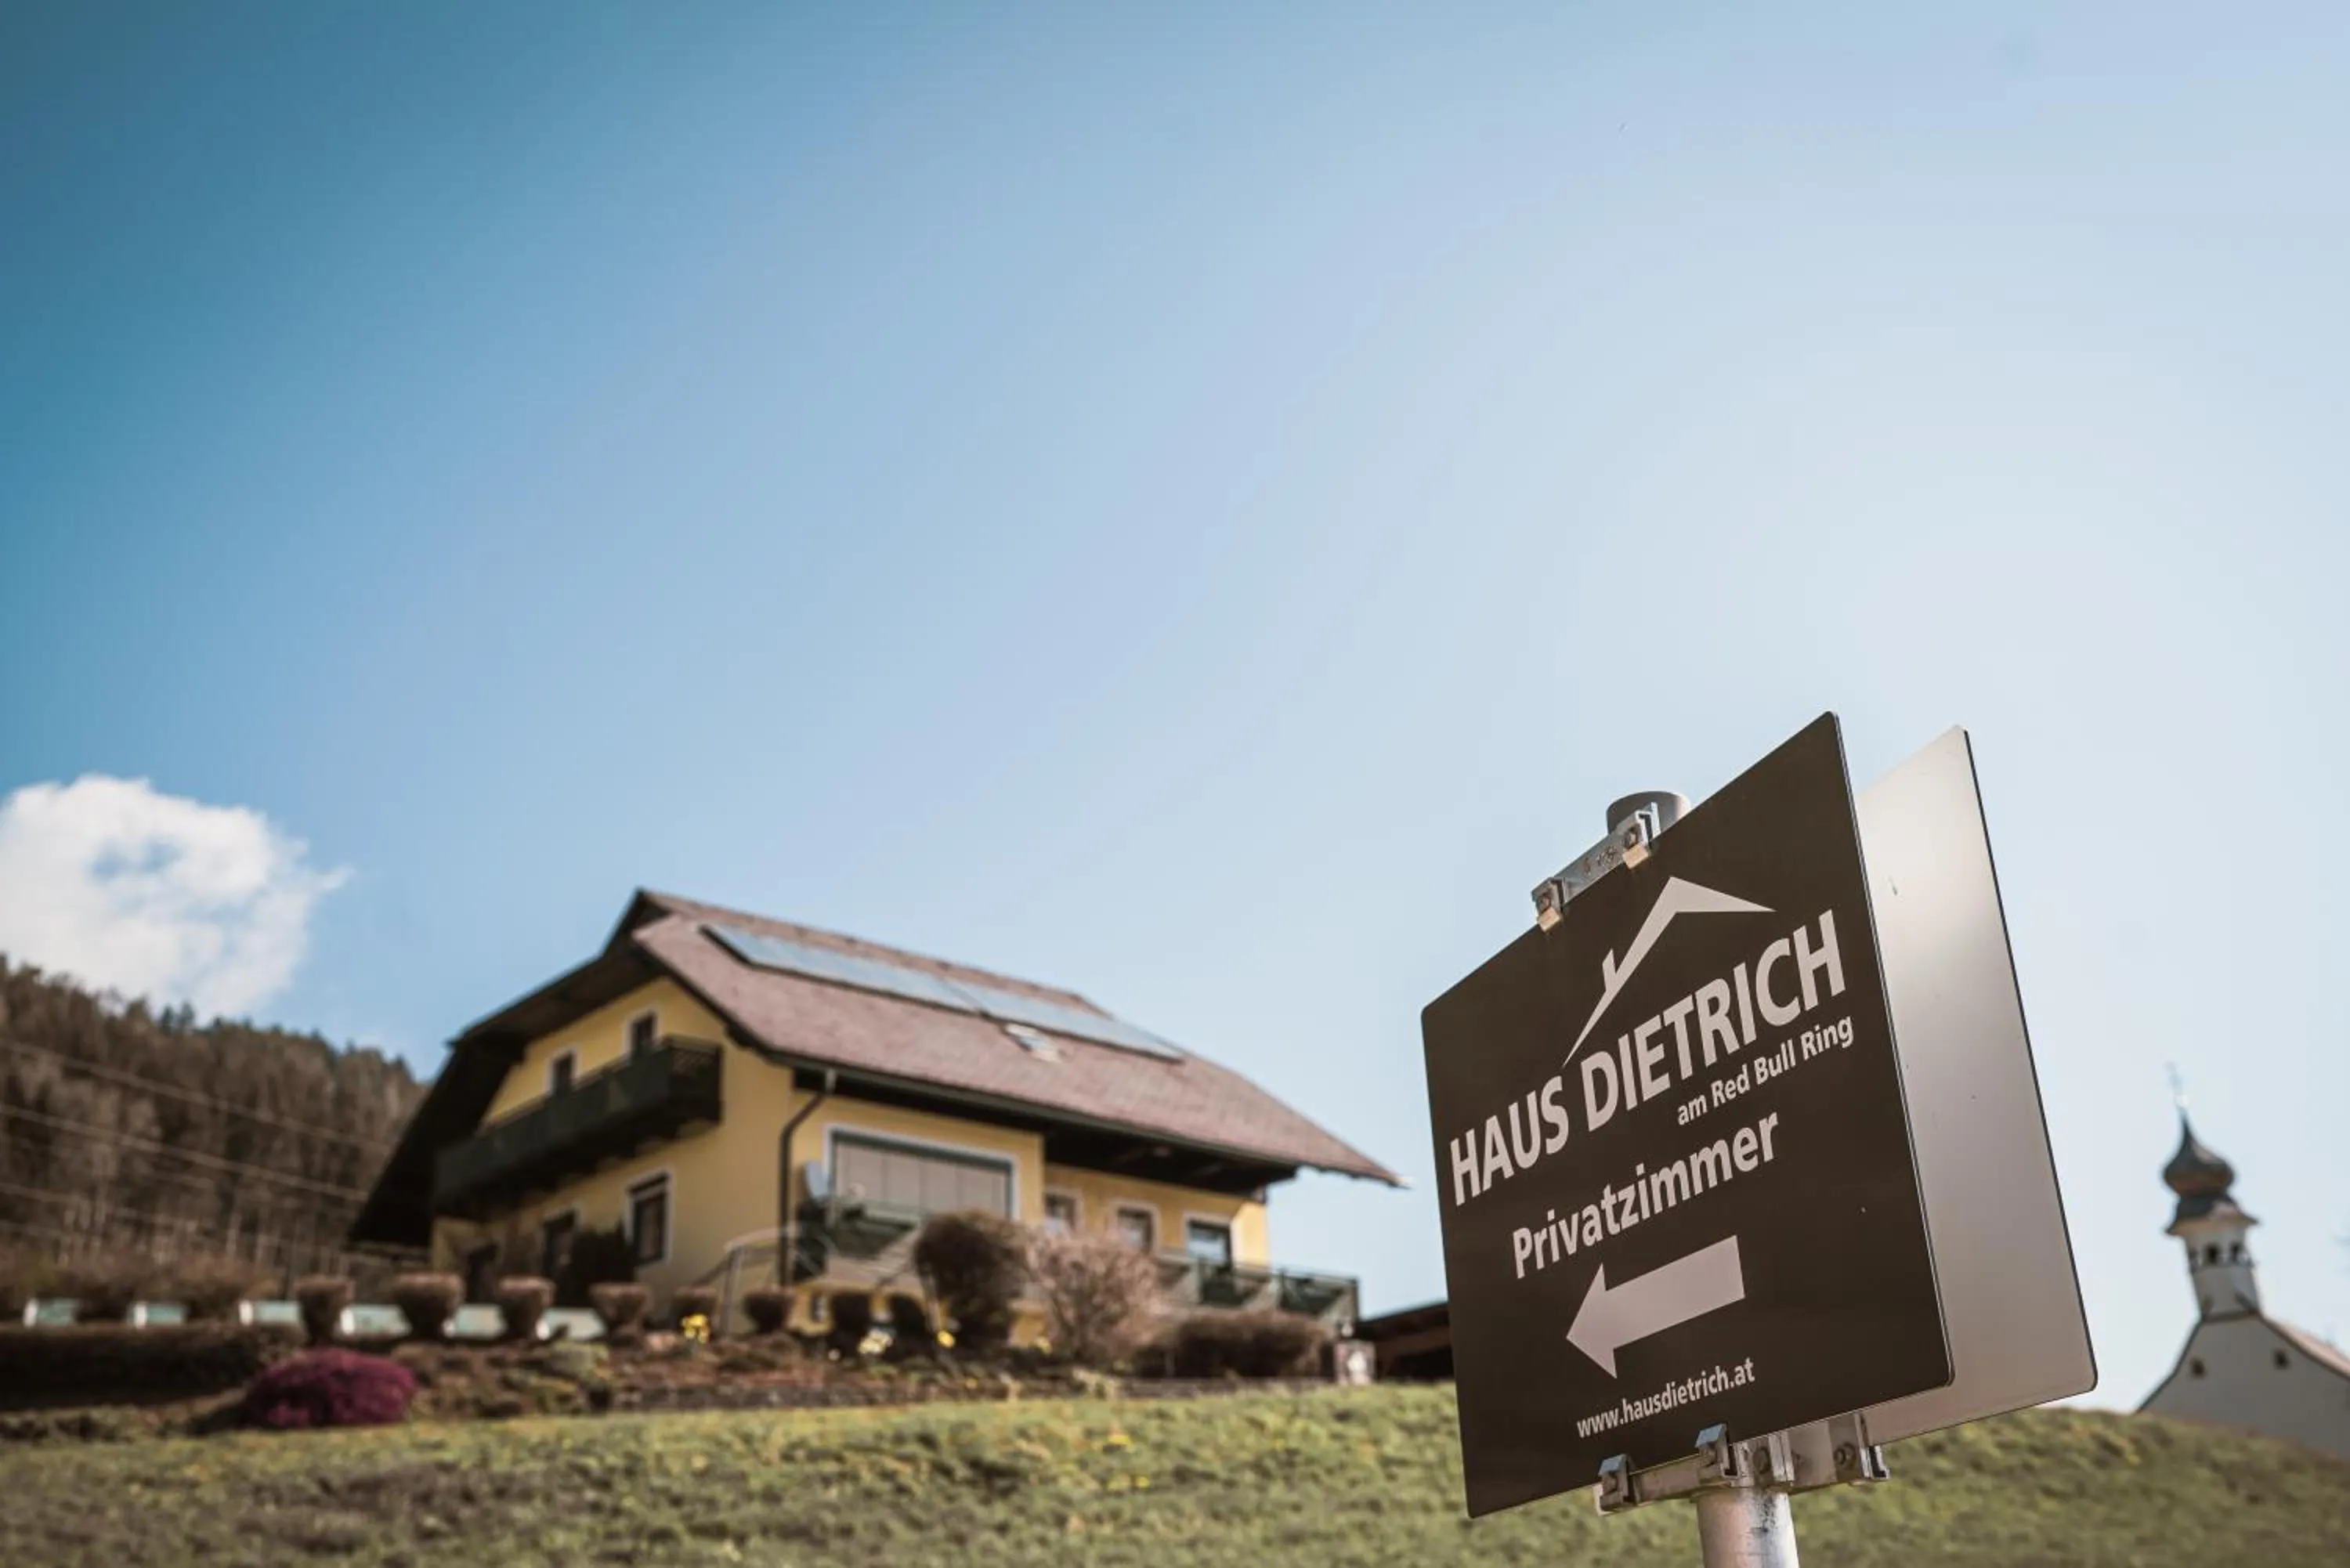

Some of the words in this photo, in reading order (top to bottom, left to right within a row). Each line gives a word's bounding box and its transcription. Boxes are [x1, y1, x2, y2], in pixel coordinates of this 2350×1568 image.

[1450, 1075, 1569, 1207] HAUS
[1580, 909, 1847, 1132] DIETRICH
[1678, 1094, 1708, 1125] am
[1710, 1063, 1751, 1108] Red
[1753, 1039, 1796, 1086] Bull
[1800, 1016, 1854, 1061] Ring
[1513, 1111, 1779, 1279] Privatzimmer
[1577, 1357, 1755, 1439] www.hausdietrich.at
